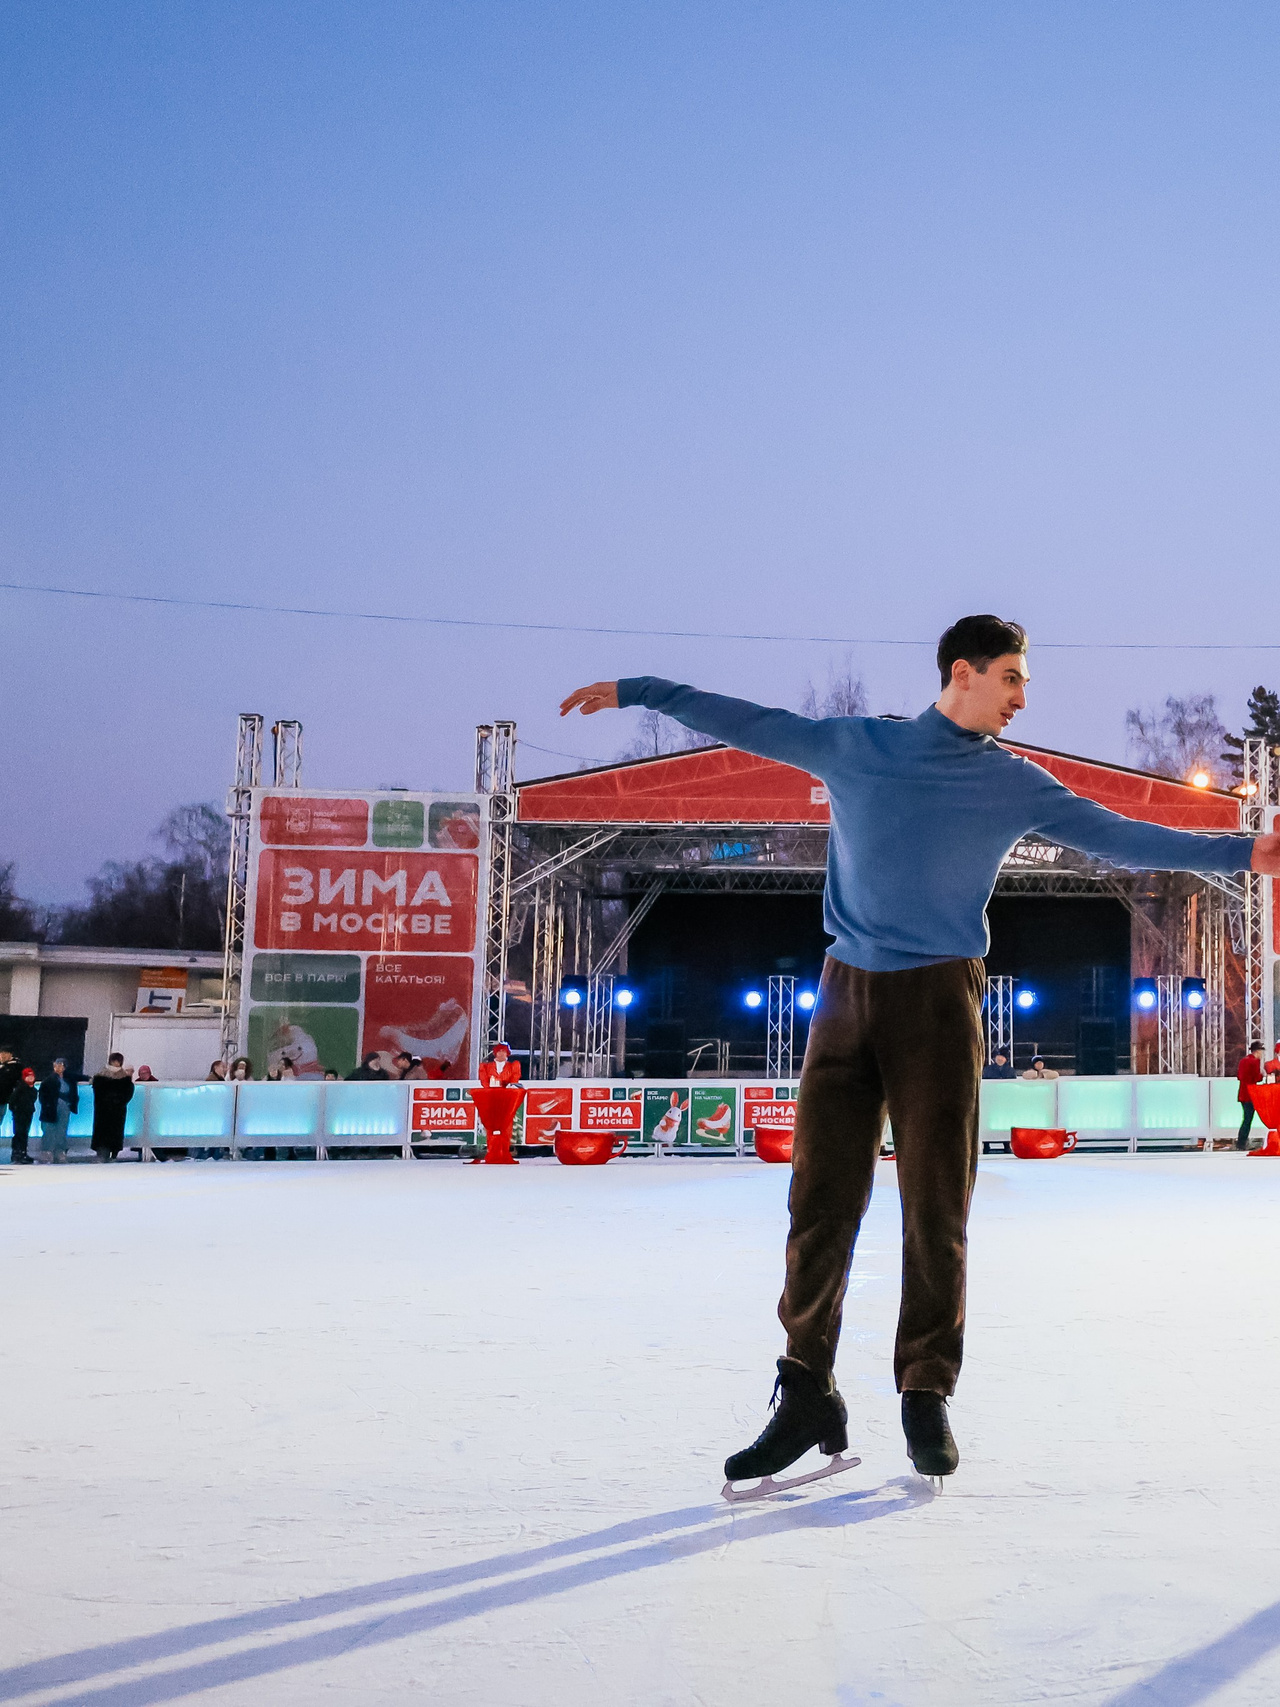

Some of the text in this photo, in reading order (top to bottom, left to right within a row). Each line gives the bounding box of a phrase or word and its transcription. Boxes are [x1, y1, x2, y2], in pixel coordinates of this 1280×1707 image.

[281, 867, 452, 907] ЗИМА
[280, 911, 452, 934] В МОСКВЕ
[376, 963, 402, 972] ВСЕ
[264, 973, 347, 983] ВСЕ В ПАРК!
[375, 975, 445, 984] КАТАТЬСЯ!
[421, 1107, 467, 1118] ЗИМА
[588, 1106, 633, 1117] ЗИМА
[752, 1106, 796, 1116] ЗИМА
